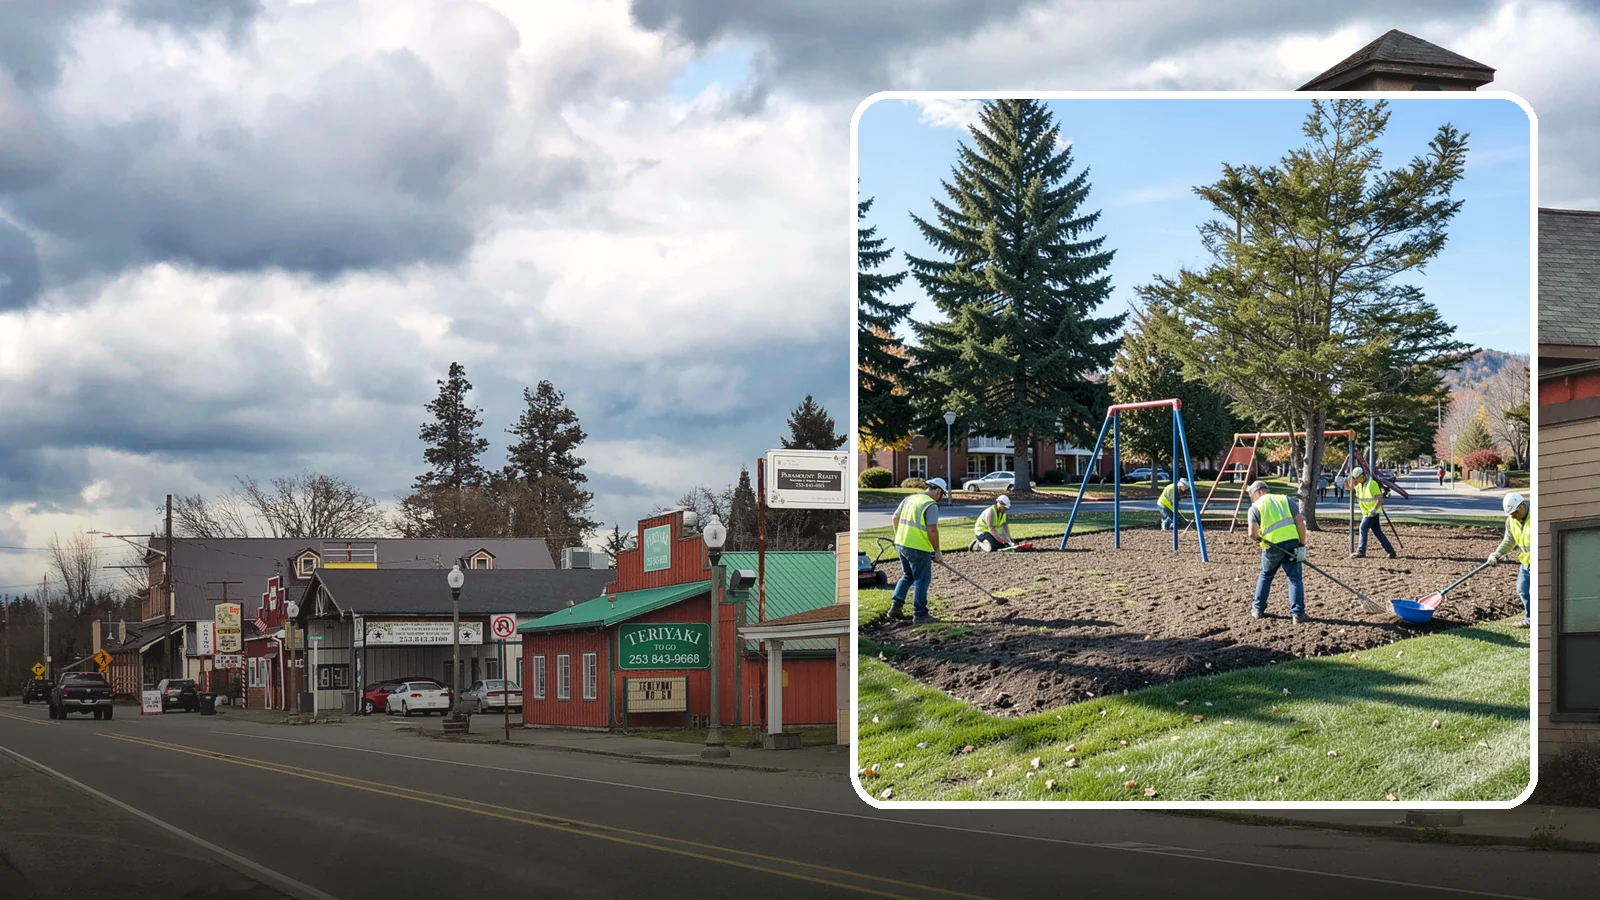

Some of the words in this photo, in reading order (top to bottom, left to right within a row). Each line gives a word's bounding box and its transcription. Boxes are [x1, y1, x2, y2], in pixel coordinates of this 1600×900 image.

[781, 471, 815, 479] PARAMOUNT
[817, 472, 839, 480] REALTY
[625, 627, 703, 646] TERIYAKI
[653, 643, 665, 651] TO
[665, 643, 677, 651] GO
[628, 654, 649, 665] 253
[651, 653, 700, 664] 843-9668
